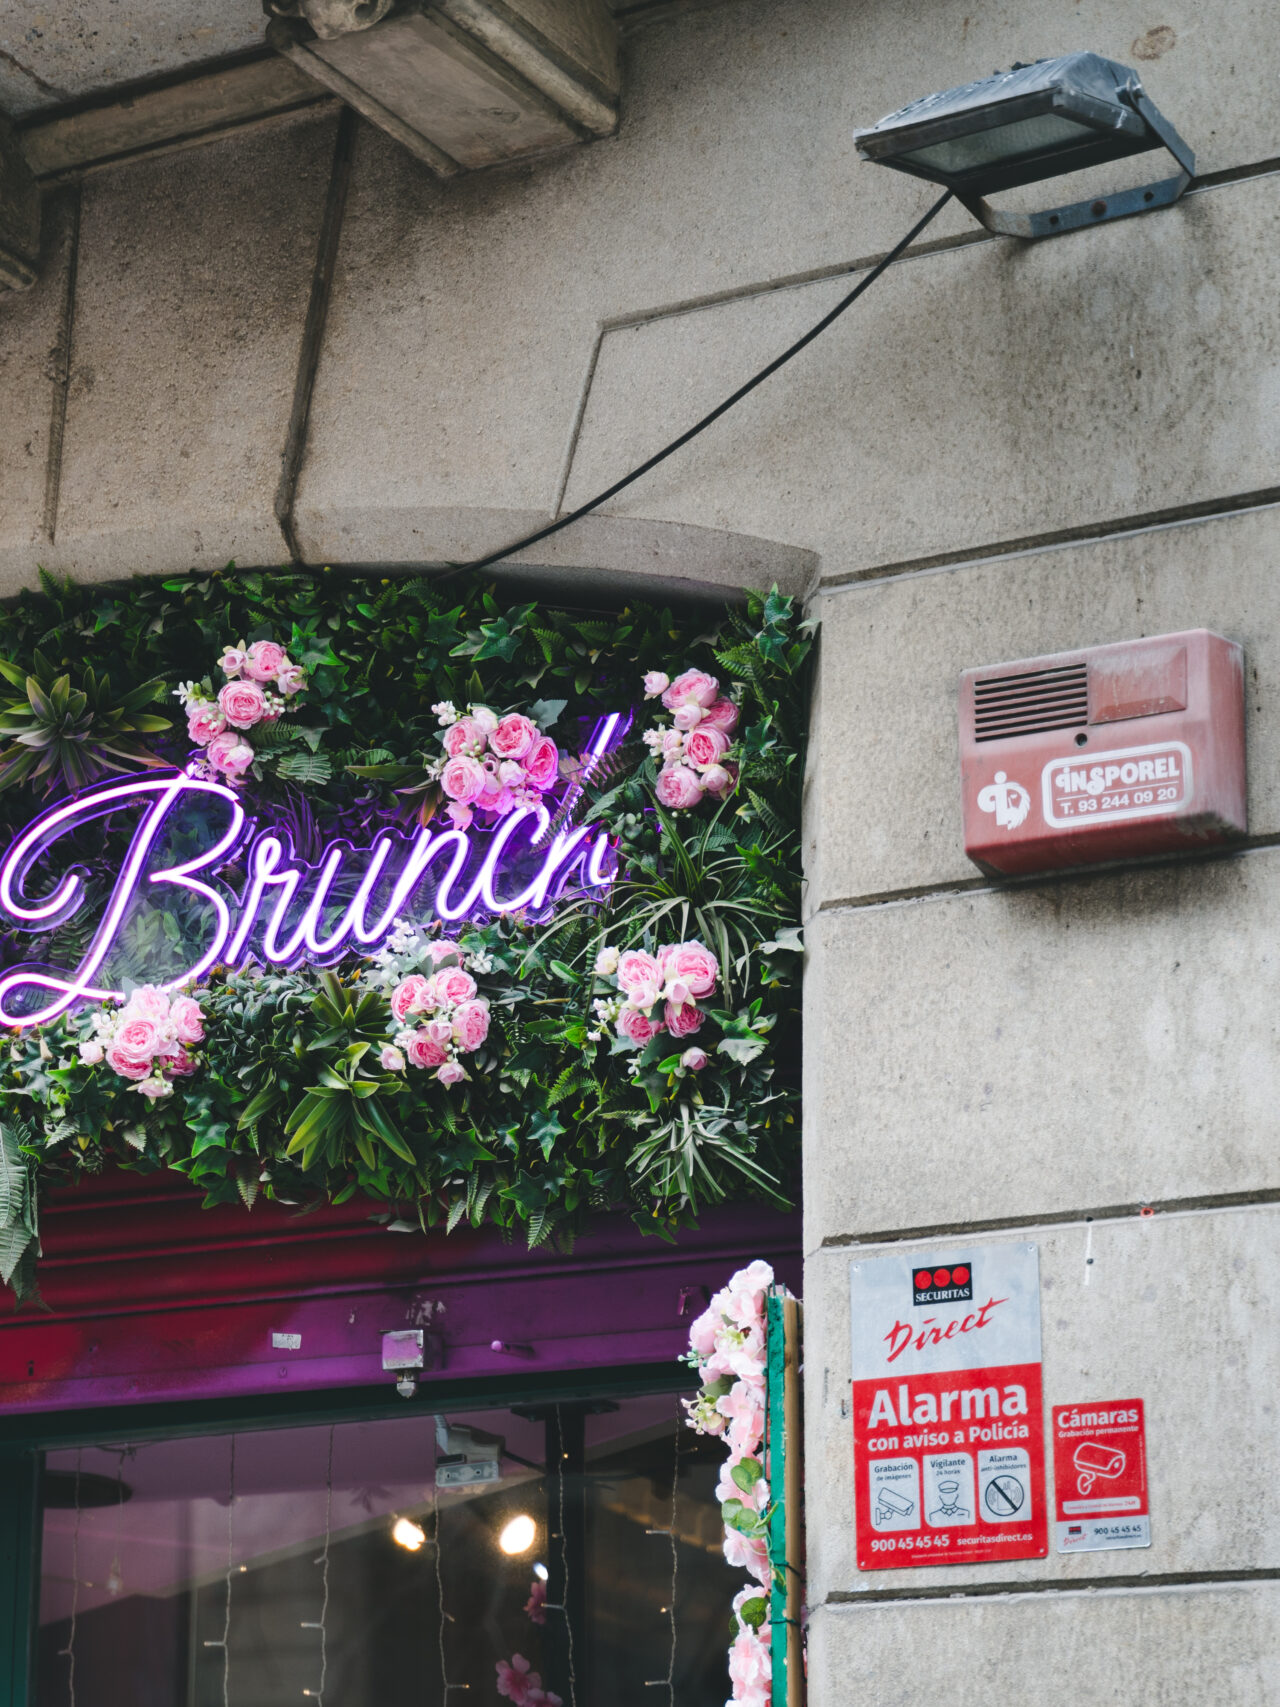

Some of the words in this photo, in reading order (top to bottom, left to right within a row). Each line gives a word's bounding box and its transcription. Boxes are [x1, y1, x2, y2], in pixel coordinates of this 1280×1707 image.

[1060, 802, 1074, 815] T.
[1078, 799, 1097, 812] 93
[1101, 794, 1130, 809] 244
[1134, 790, 1153, 804] 09
[1157, 787, 1177, 801] 20
[915, 1287, 970, 1302] SECURITAS
[883, 1297, 1010, 1363] Direct
[867, 1384, 1028, 1429] Alarma
[1057, 1408, 1139, 1428] Cámaras
[867, 1436, 899, 1452] con
[903, 1429, 949, 1449] aviso
[953, 1430, 965, 1444] a
[969, 1420, 1029, 1443] Policía
[1058, 1428, 1094, 1438] Grabación
[930, 1458, 966, 1470] Vigilante
[989, 1454, 1018, 1463] Alarma
[874, 1462, 913, 1474] Grabación
[945, 1468, 961, 1476] horas
[871, 1538, 896, 1552] 900
[898, 1536, 914, 1550] 45
[915, 1535, 931, 1548] 45
[933, 1534, 950, 1547] 45
[957, 1532, 1033, 1546] securitasdirect.es
